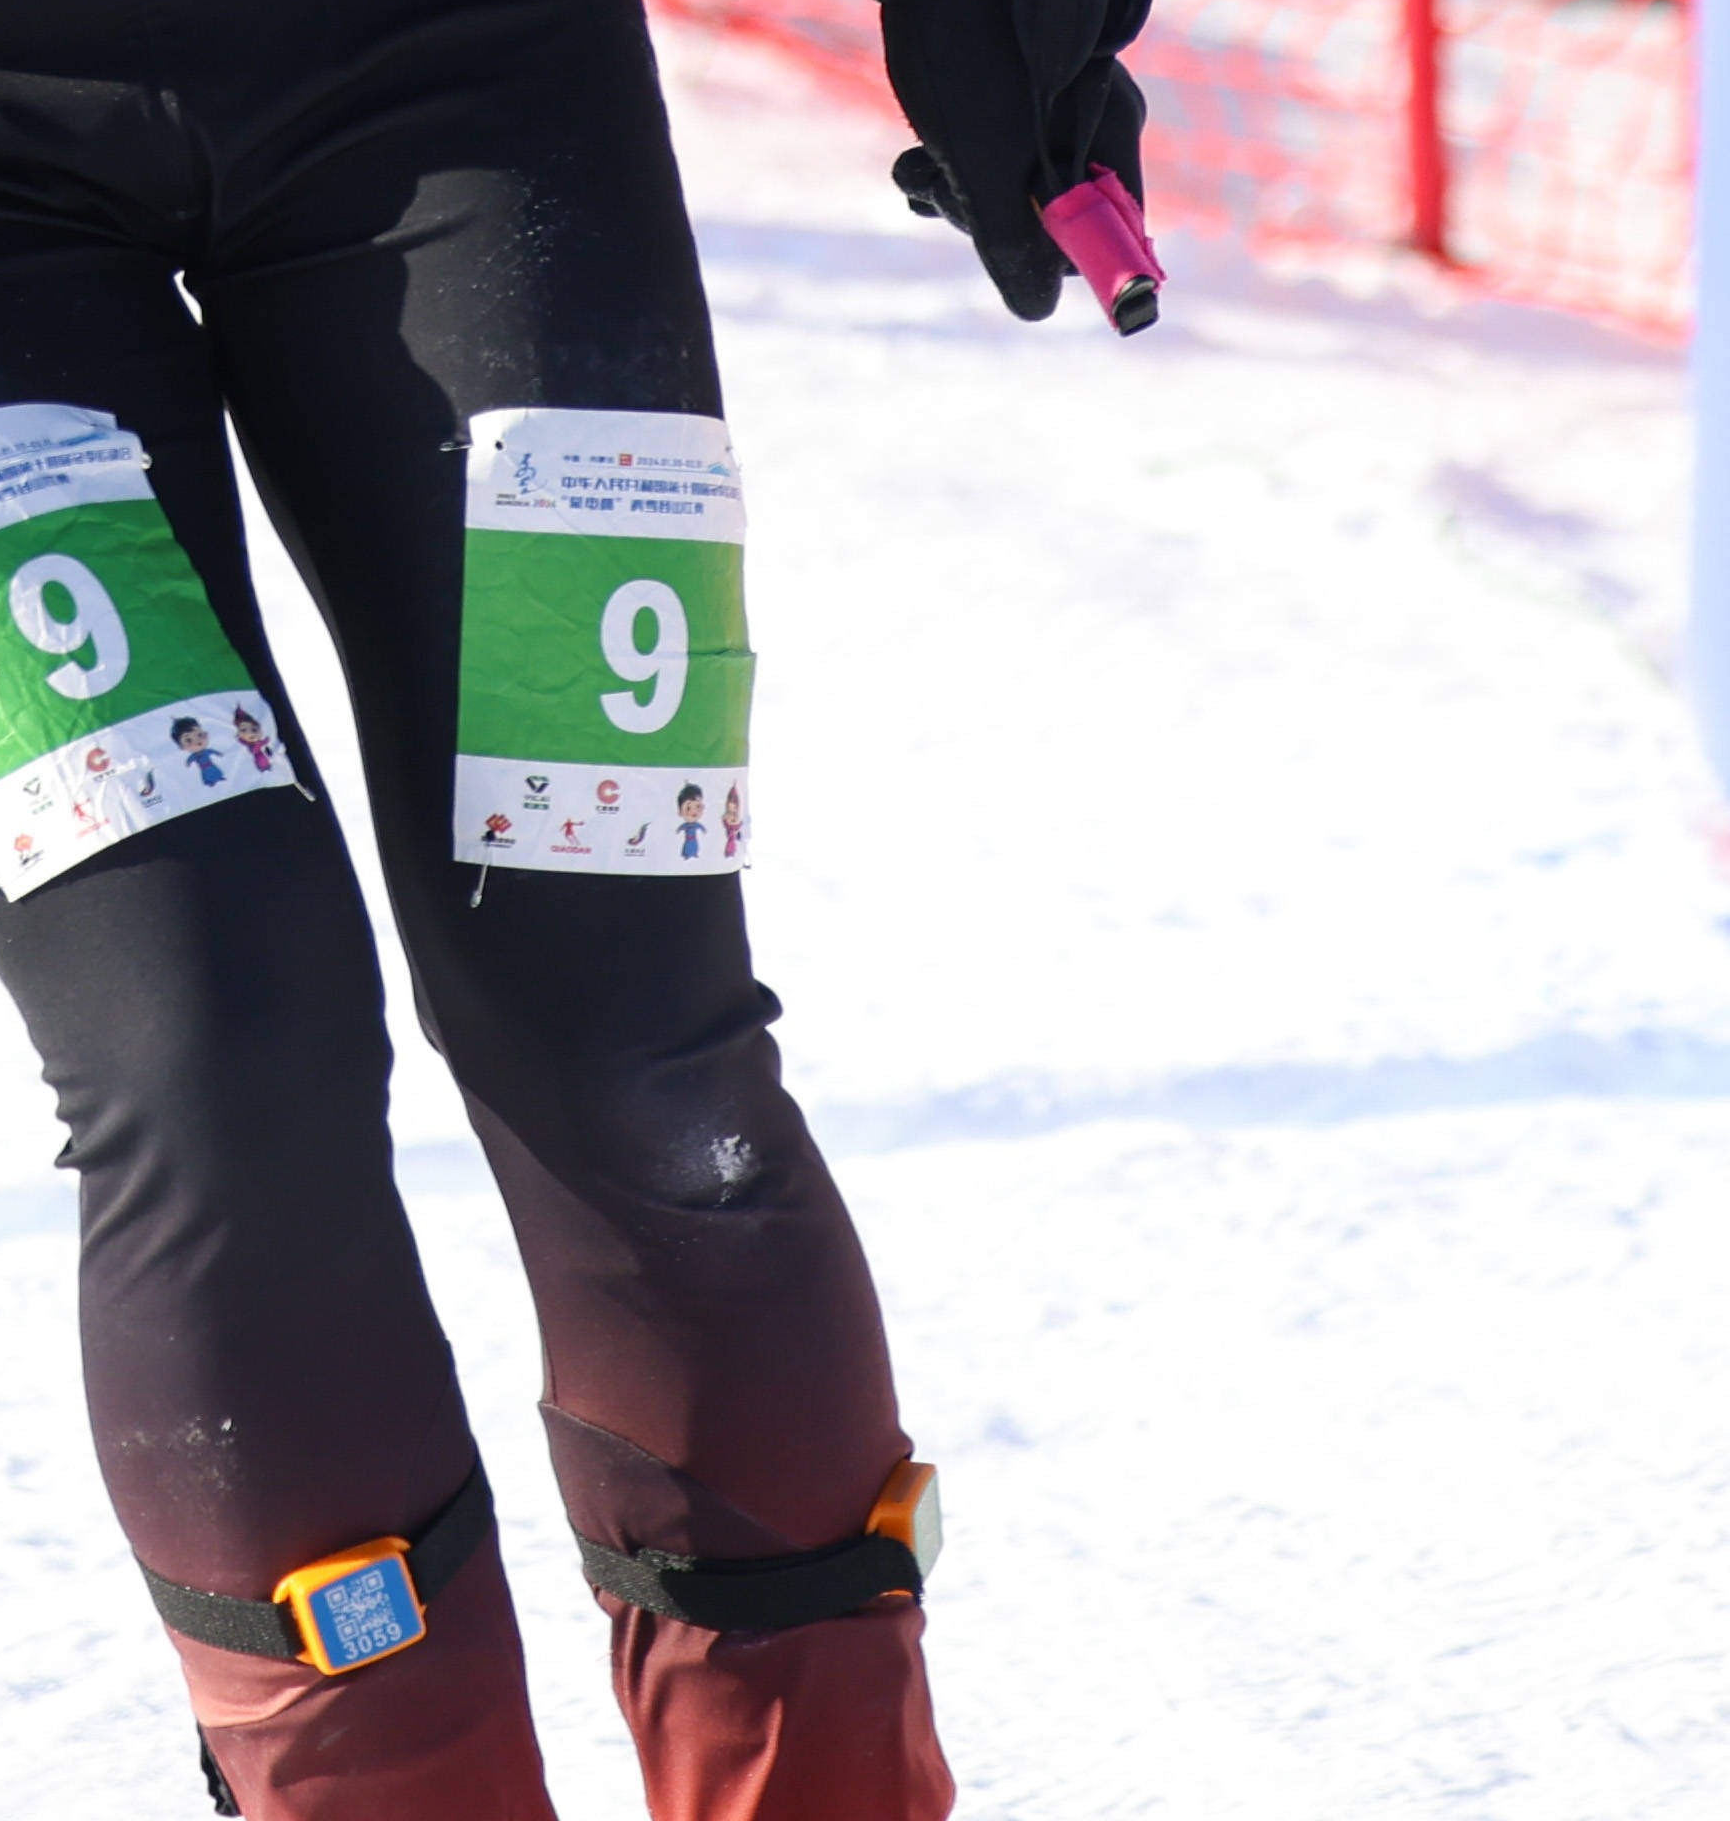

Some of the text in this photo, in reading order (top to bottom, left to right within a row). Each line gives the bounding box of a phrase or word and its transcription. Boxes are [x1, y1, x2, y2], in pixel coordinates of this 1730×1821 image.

[8, 552, 131, 701] 9
[599, 578, 690, 735] 9
[343, 1622, 403, 1661] 3059
